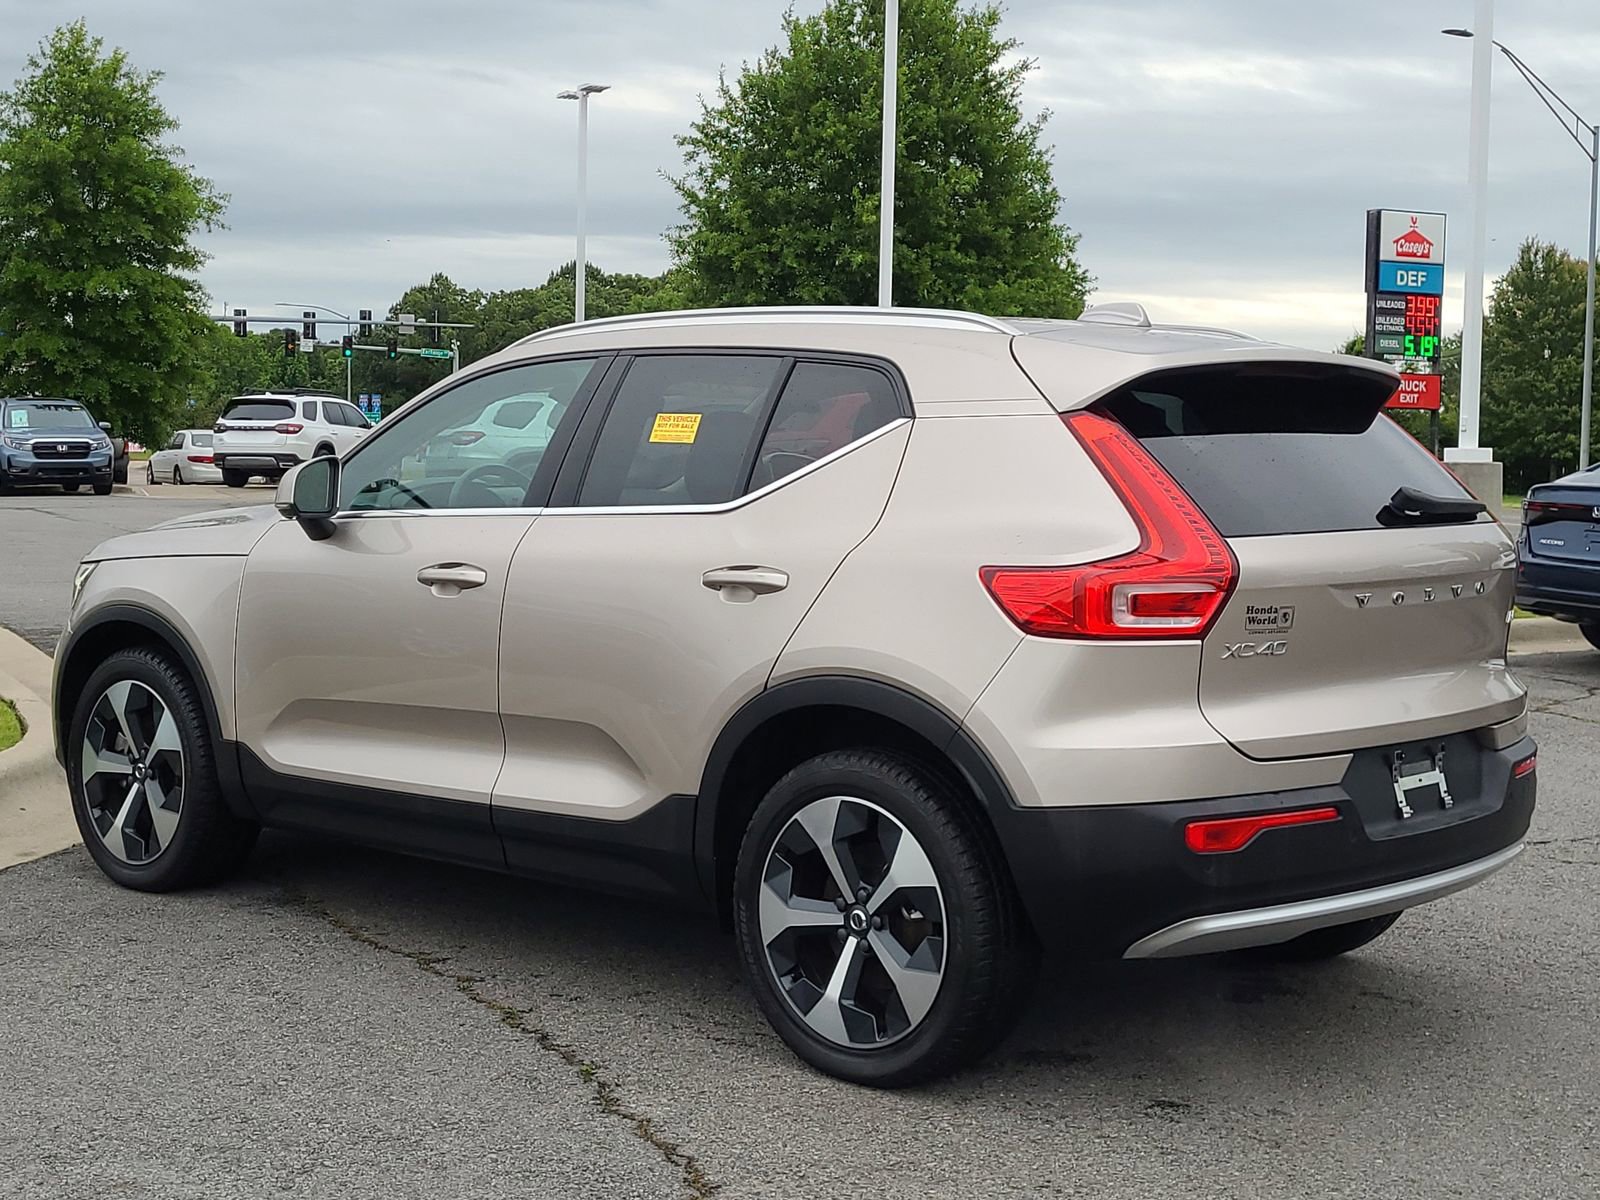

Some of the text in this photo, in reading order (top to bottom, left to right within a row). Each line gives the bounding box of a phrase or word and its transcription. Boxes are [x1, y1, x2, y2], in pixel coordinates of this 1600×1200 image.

[1397, 239, 1430, 256] Casey's
[1396, 270, 1427, 287] DEF
[1376, 300, 1406, 309] UNLEADED
[1375, 316, 1405, 325] UNLEADED
[1380, 339, 1400, 348] DIESEL
[1398, 380, 1427, 392] RUCK
[1399, 393, 1419, 404] EXIT
[673, 415, 699, 423] VEHICLE
[1355, 581, 1486, 608] VOLVO
[1246, 605, 1278, 615] Honda
[1247, 615, 1278, 625] World
[1220, 639, 1288, 660] XC40
